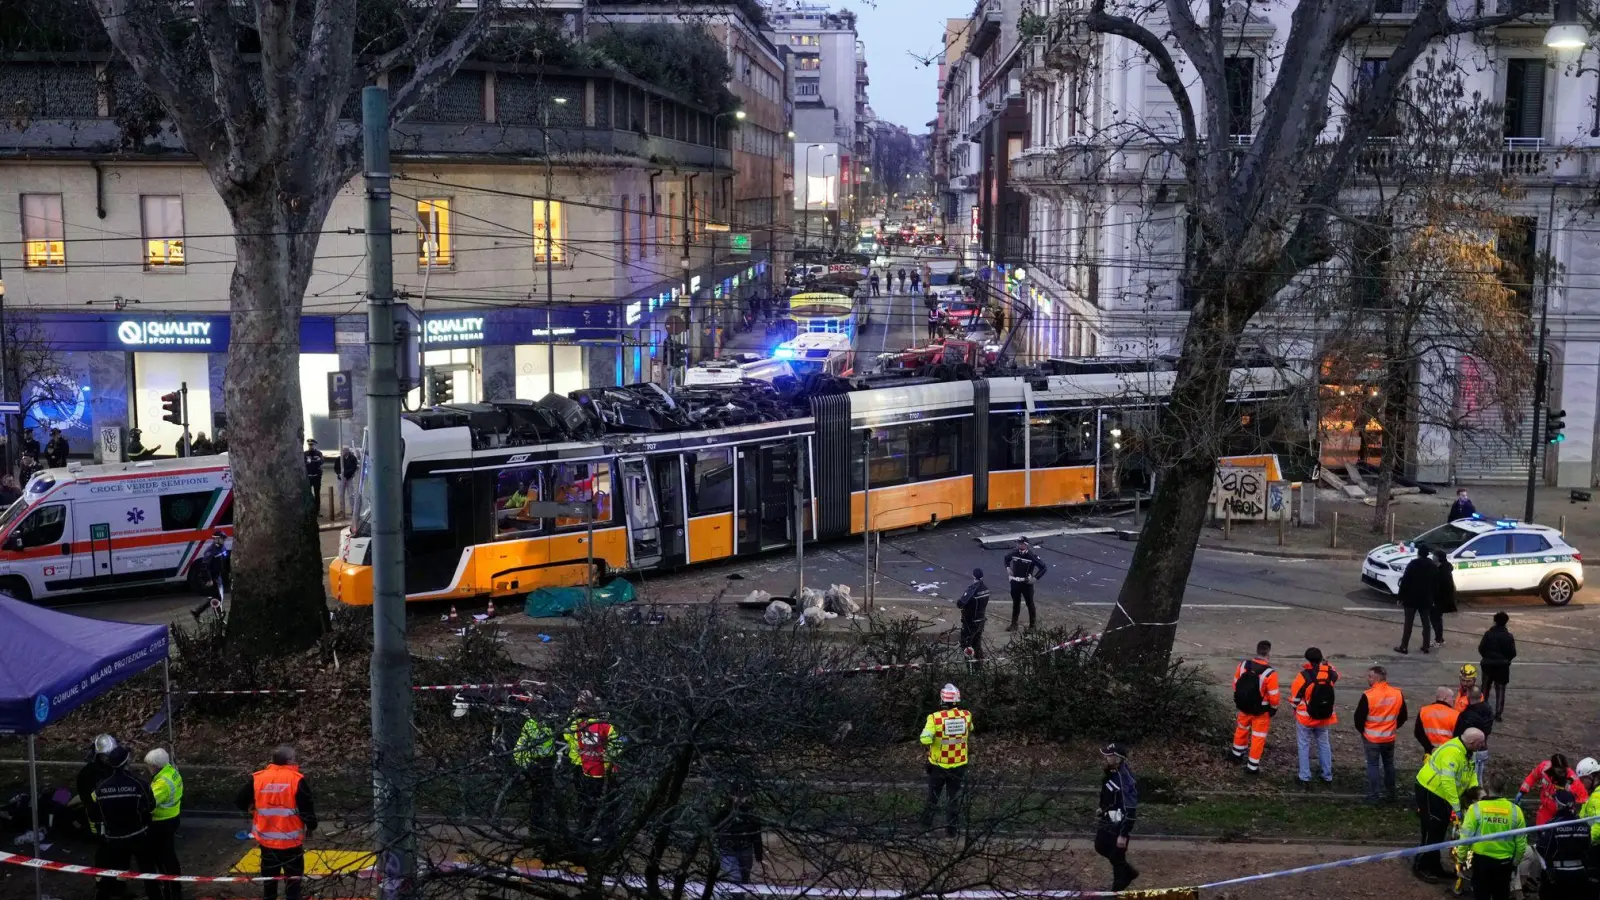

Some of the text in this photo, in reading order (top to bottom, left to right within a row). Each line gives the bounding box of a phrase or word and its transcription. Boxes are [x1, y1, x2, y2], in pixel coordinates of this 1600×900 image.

[147, 321, 211, 336] QUALITY
[427, 318, 484, 333] QUALITY
[428, 335, 452, 343] SPORT
[460, 333, 484, 341] REHAB
[333, 374, 347, 392] P
[90, 477, 209, 493] CROCE VERDE SEMPIONE
[1467, 560, 1492, 569] Polizia
[1514, 556, 1539, 565] Locale
[52, 636, 166, 706] COMUNE DI MILANO PROTEZIONE CIVILE
[1487, 816, 1508, 825] AREU
